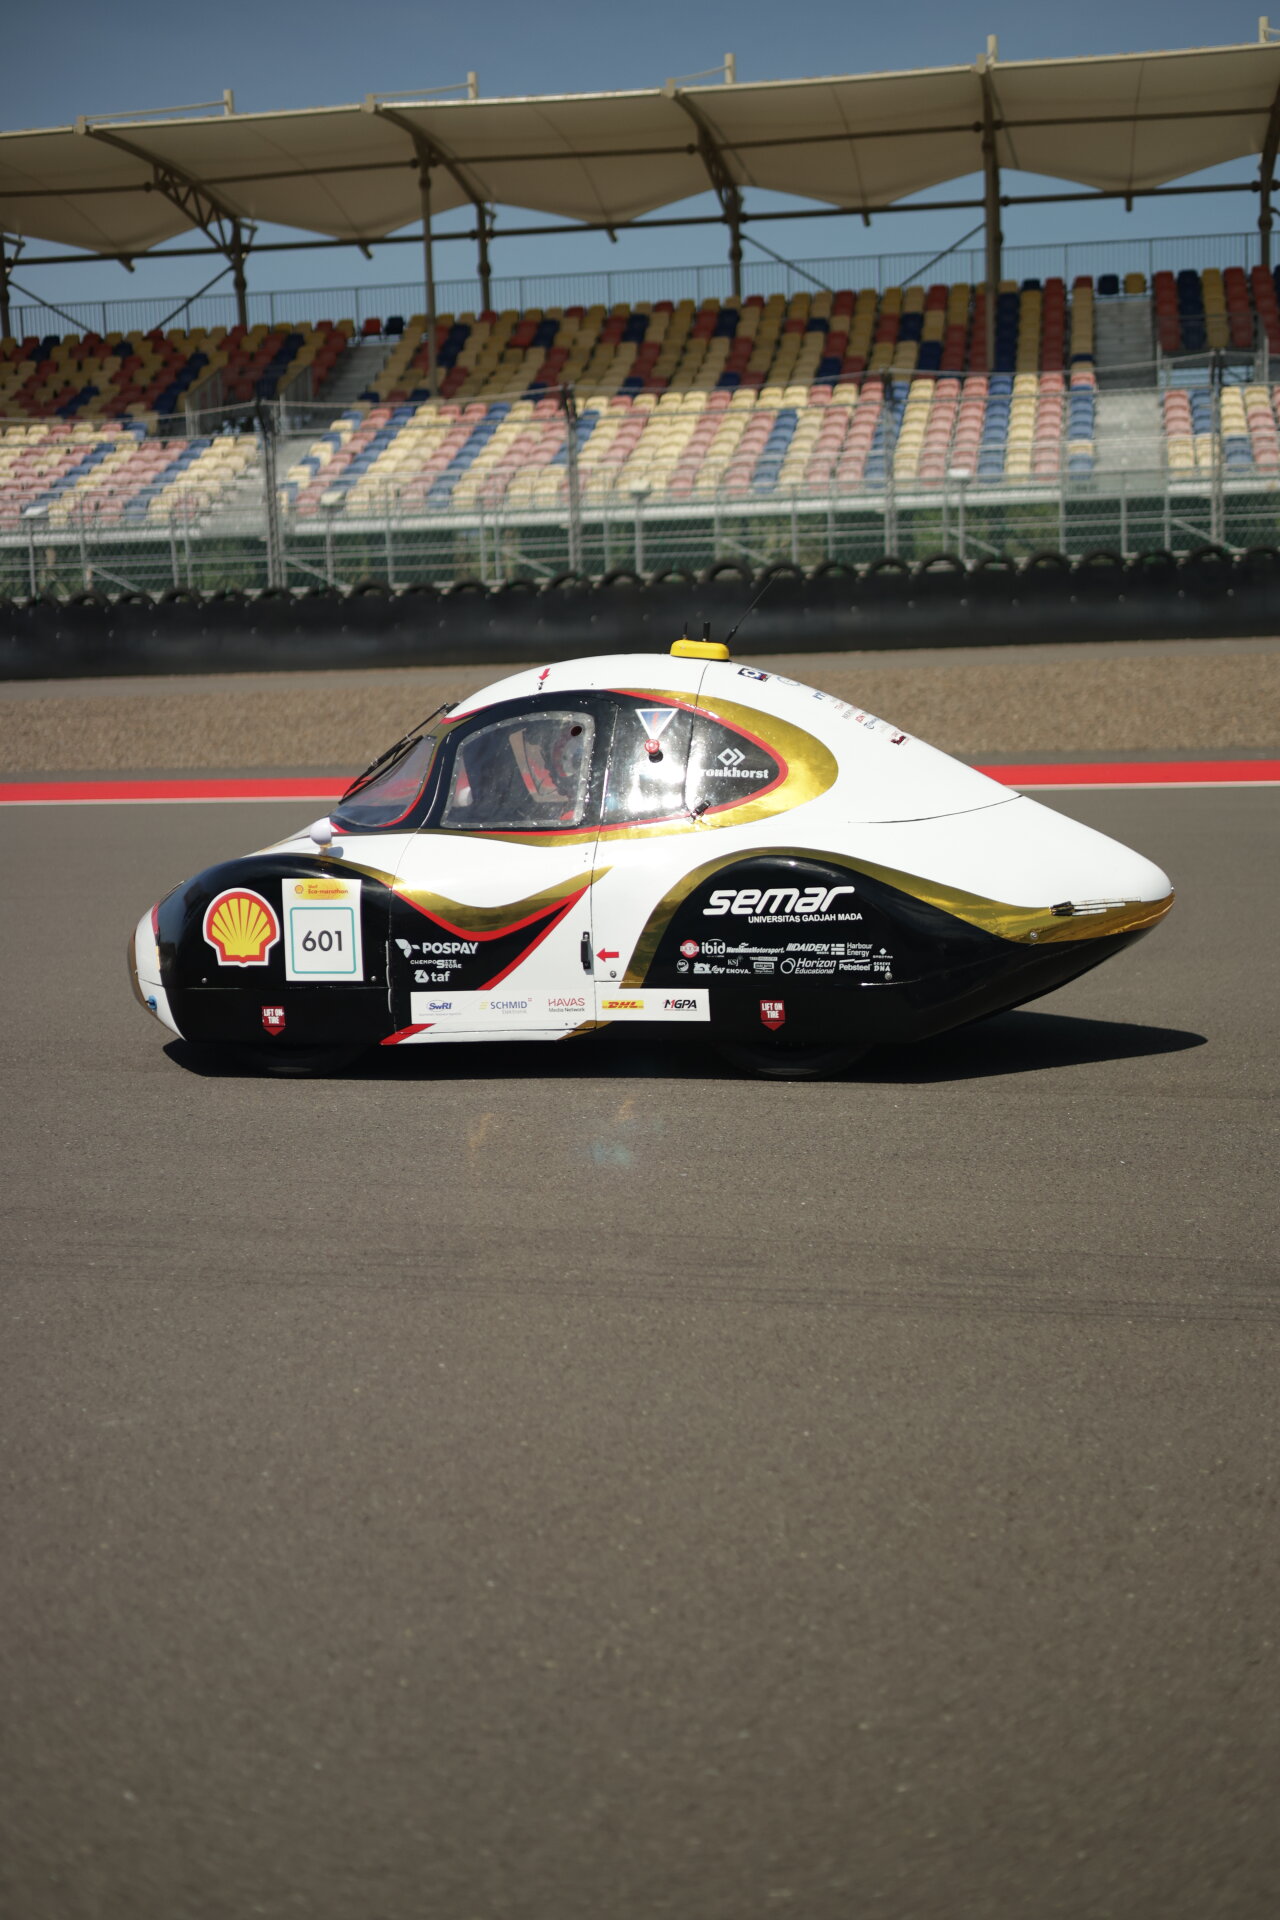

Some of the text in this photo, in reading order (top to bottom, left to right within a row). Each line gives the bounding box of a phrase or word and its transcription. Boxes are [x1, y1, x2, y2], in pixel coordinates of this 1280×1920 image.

[701, 767, 769, 779] ronkhorst
[702, 886, 855, 915] semar
[748, 913, 862, 923] UNIVERSITAS GADJAH MADA
[302, 930, 342, 951] 601
[422, 942, 478, 954] POSPAY
[701, 942, 725, 954] ibid
[790, 943, 830, 952] DAIDEN
[847, 949, 869, 957] Energy
[797, 958, 836, 967] Horizon
[431, 971, 450, 982] taf
[490, 1001, 527, 1010] SCHMID
[548, 997, 585, 1006] HAVAS
[608, 1001, 639, 1009] DHL
[429, 1002, 452, 1011] SwRI
